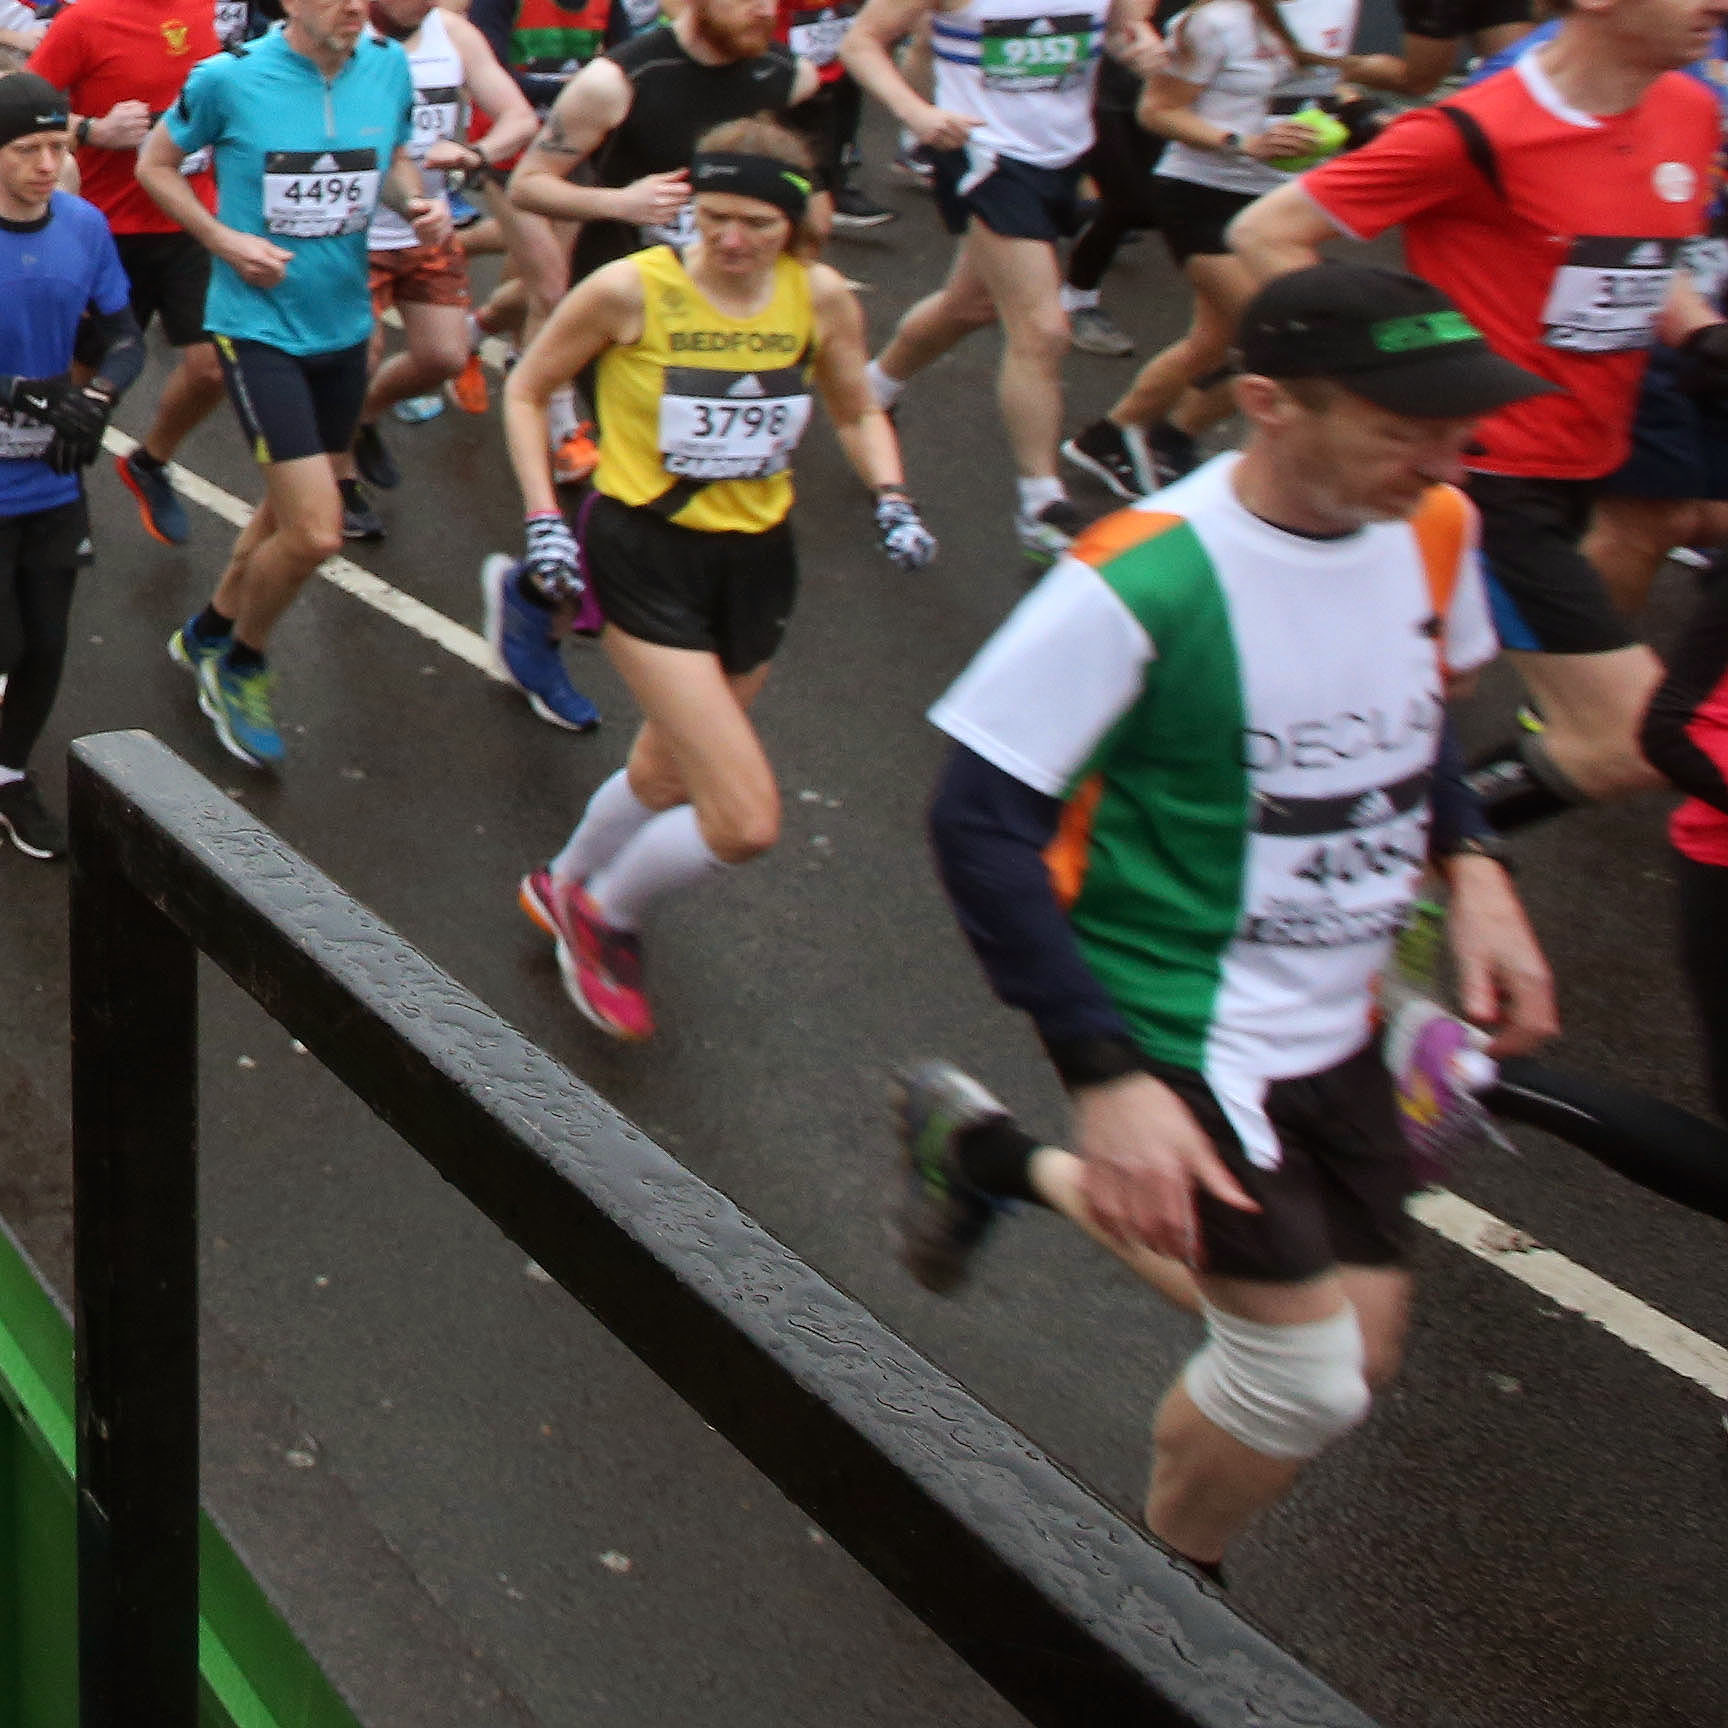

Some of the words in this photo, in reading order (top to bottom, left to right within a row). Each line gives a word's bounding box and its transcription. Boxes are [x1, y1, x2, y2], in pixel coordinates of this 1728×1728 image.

[285, 177, 362, 204] 4496
[671, 331, 796, 352] BEDFORD
[692, 404, 787, 437] 3798
